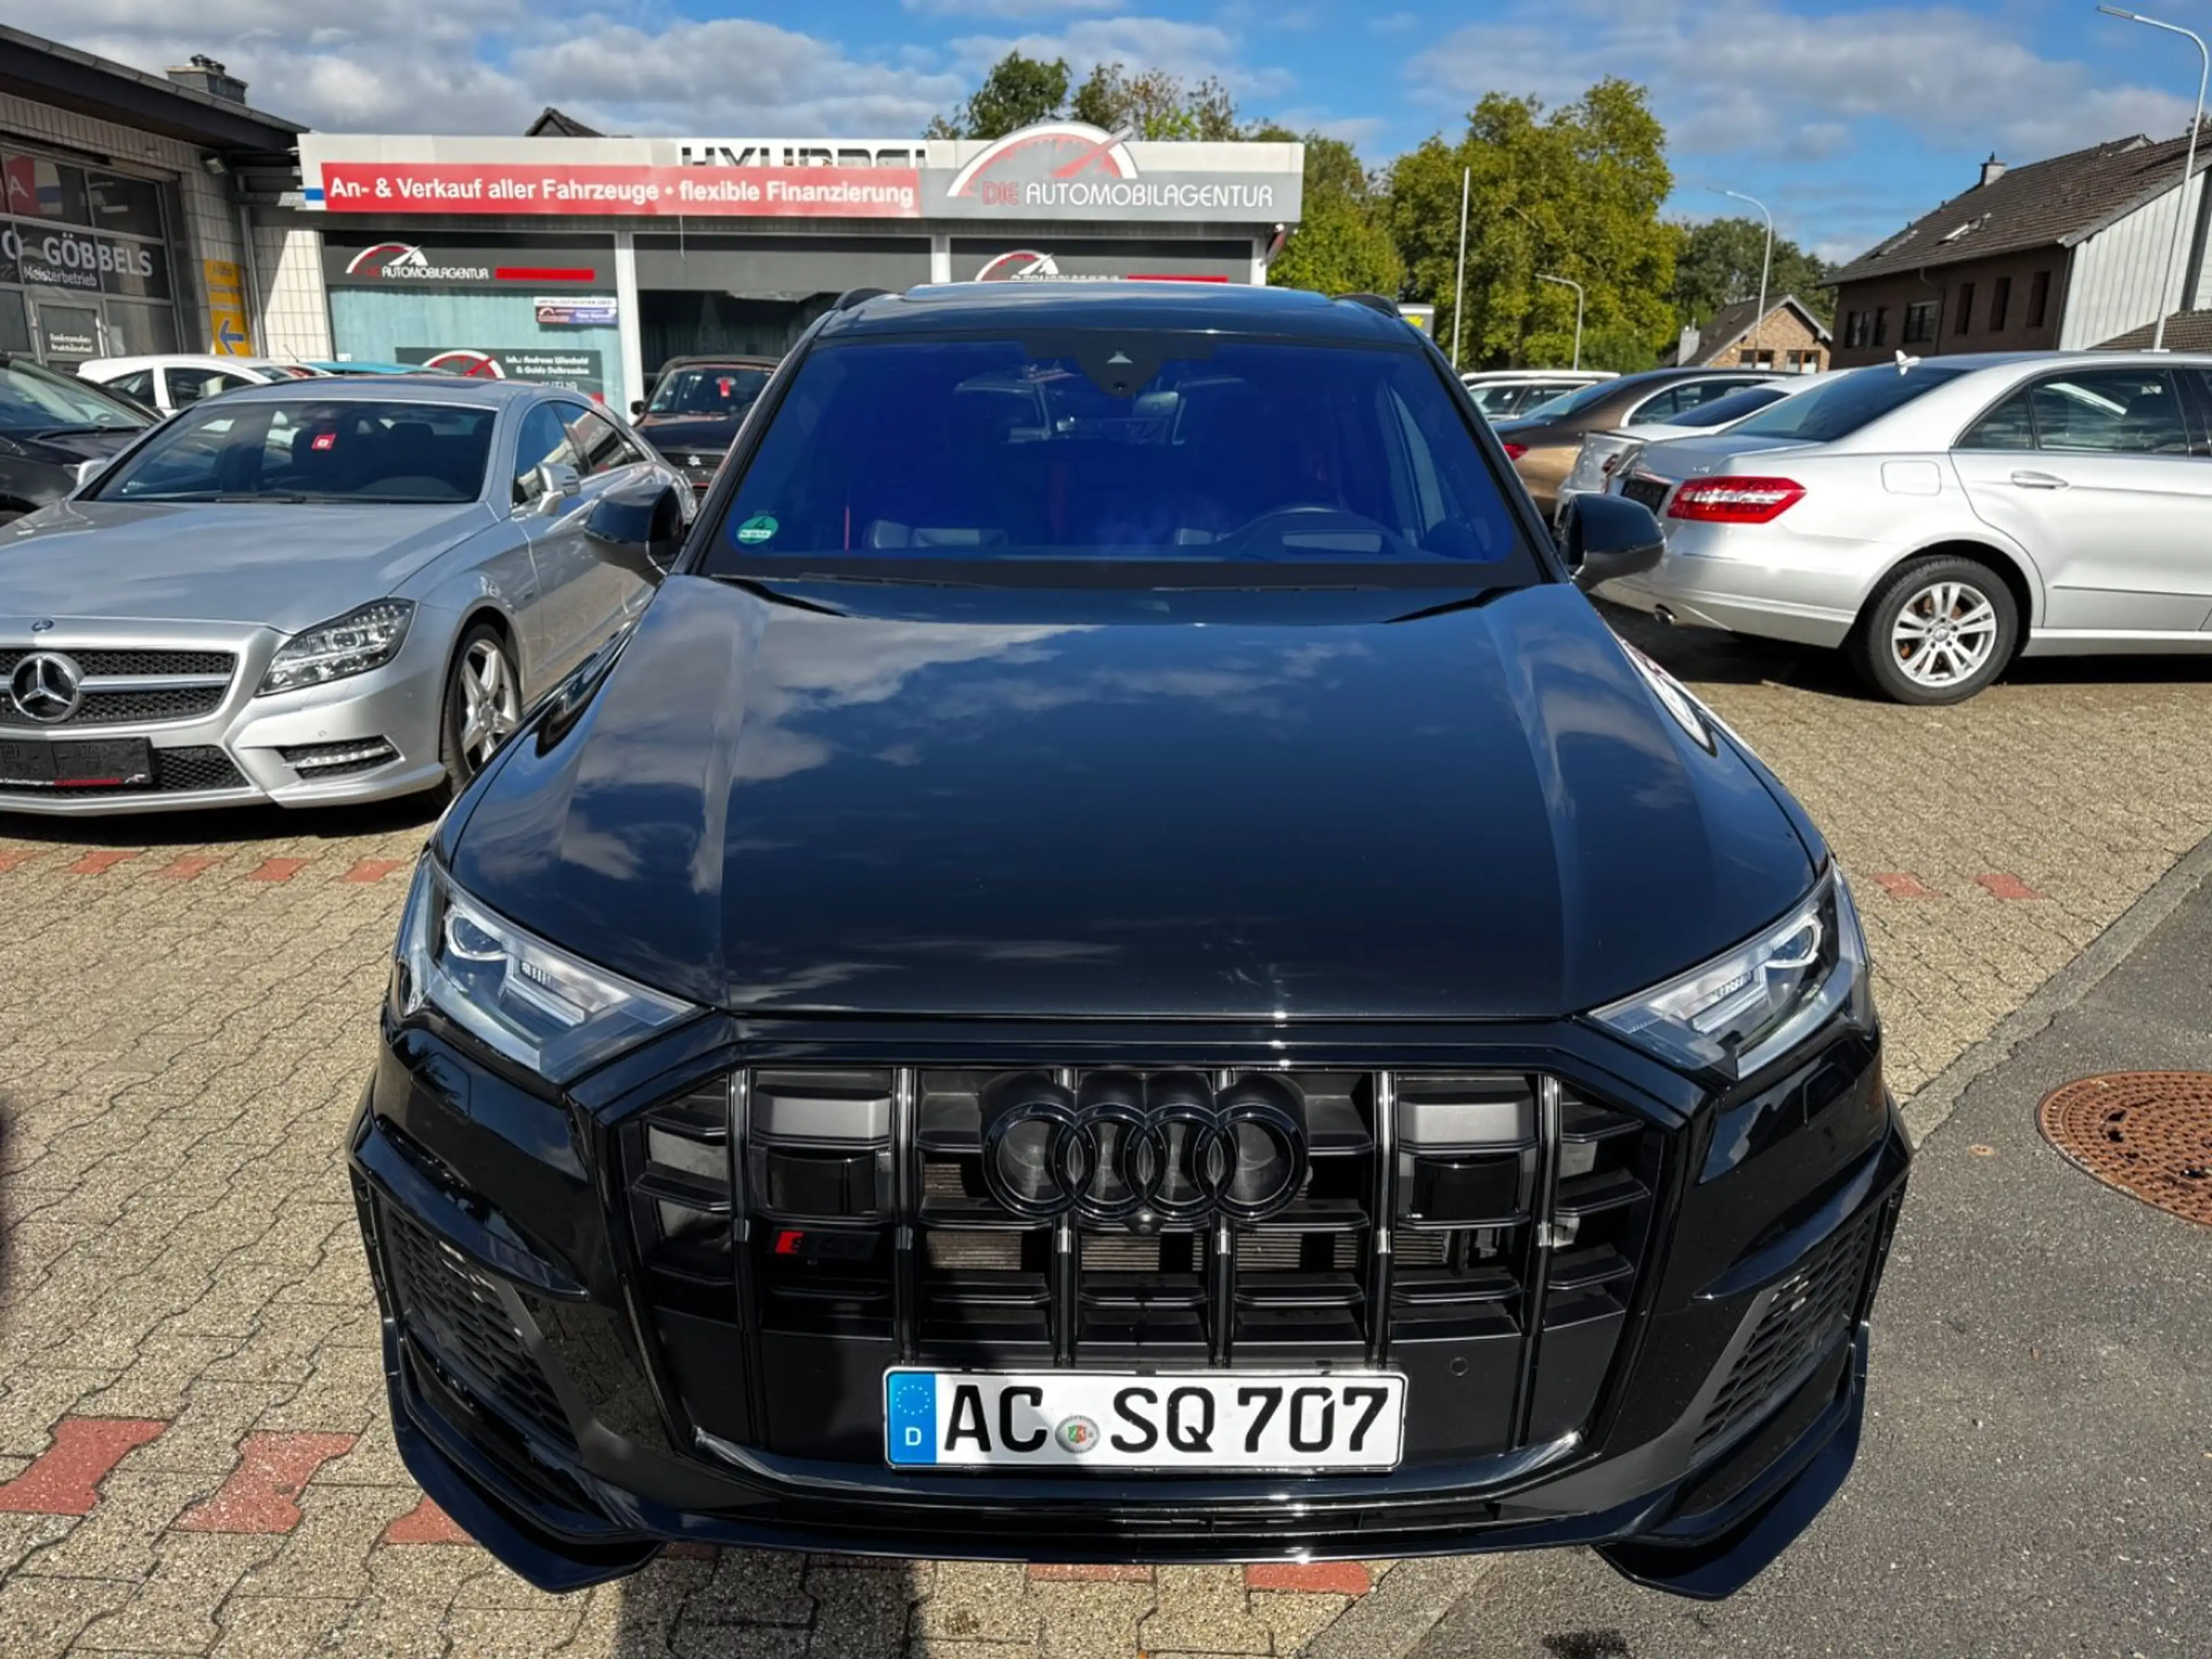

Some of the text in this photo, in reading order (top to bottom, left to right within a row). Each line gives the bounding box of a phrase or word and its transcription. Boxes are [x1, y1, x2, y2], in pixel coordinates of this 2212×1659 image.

[329, 177, 914, 208] An- & Verkauf aller Fahrzeuge flexible Finanzierung
[982, 181, 1274, 208] DIE AUTOMOBILAGENTUR
[43, 232, 153, 277] GÖBBELS
[382, 266, 489, 280] AUTOMOBILAGENTUR
[945, 1385, 1388, 1453] AC SQ 707
[906, 1427, 922, 1446] D
